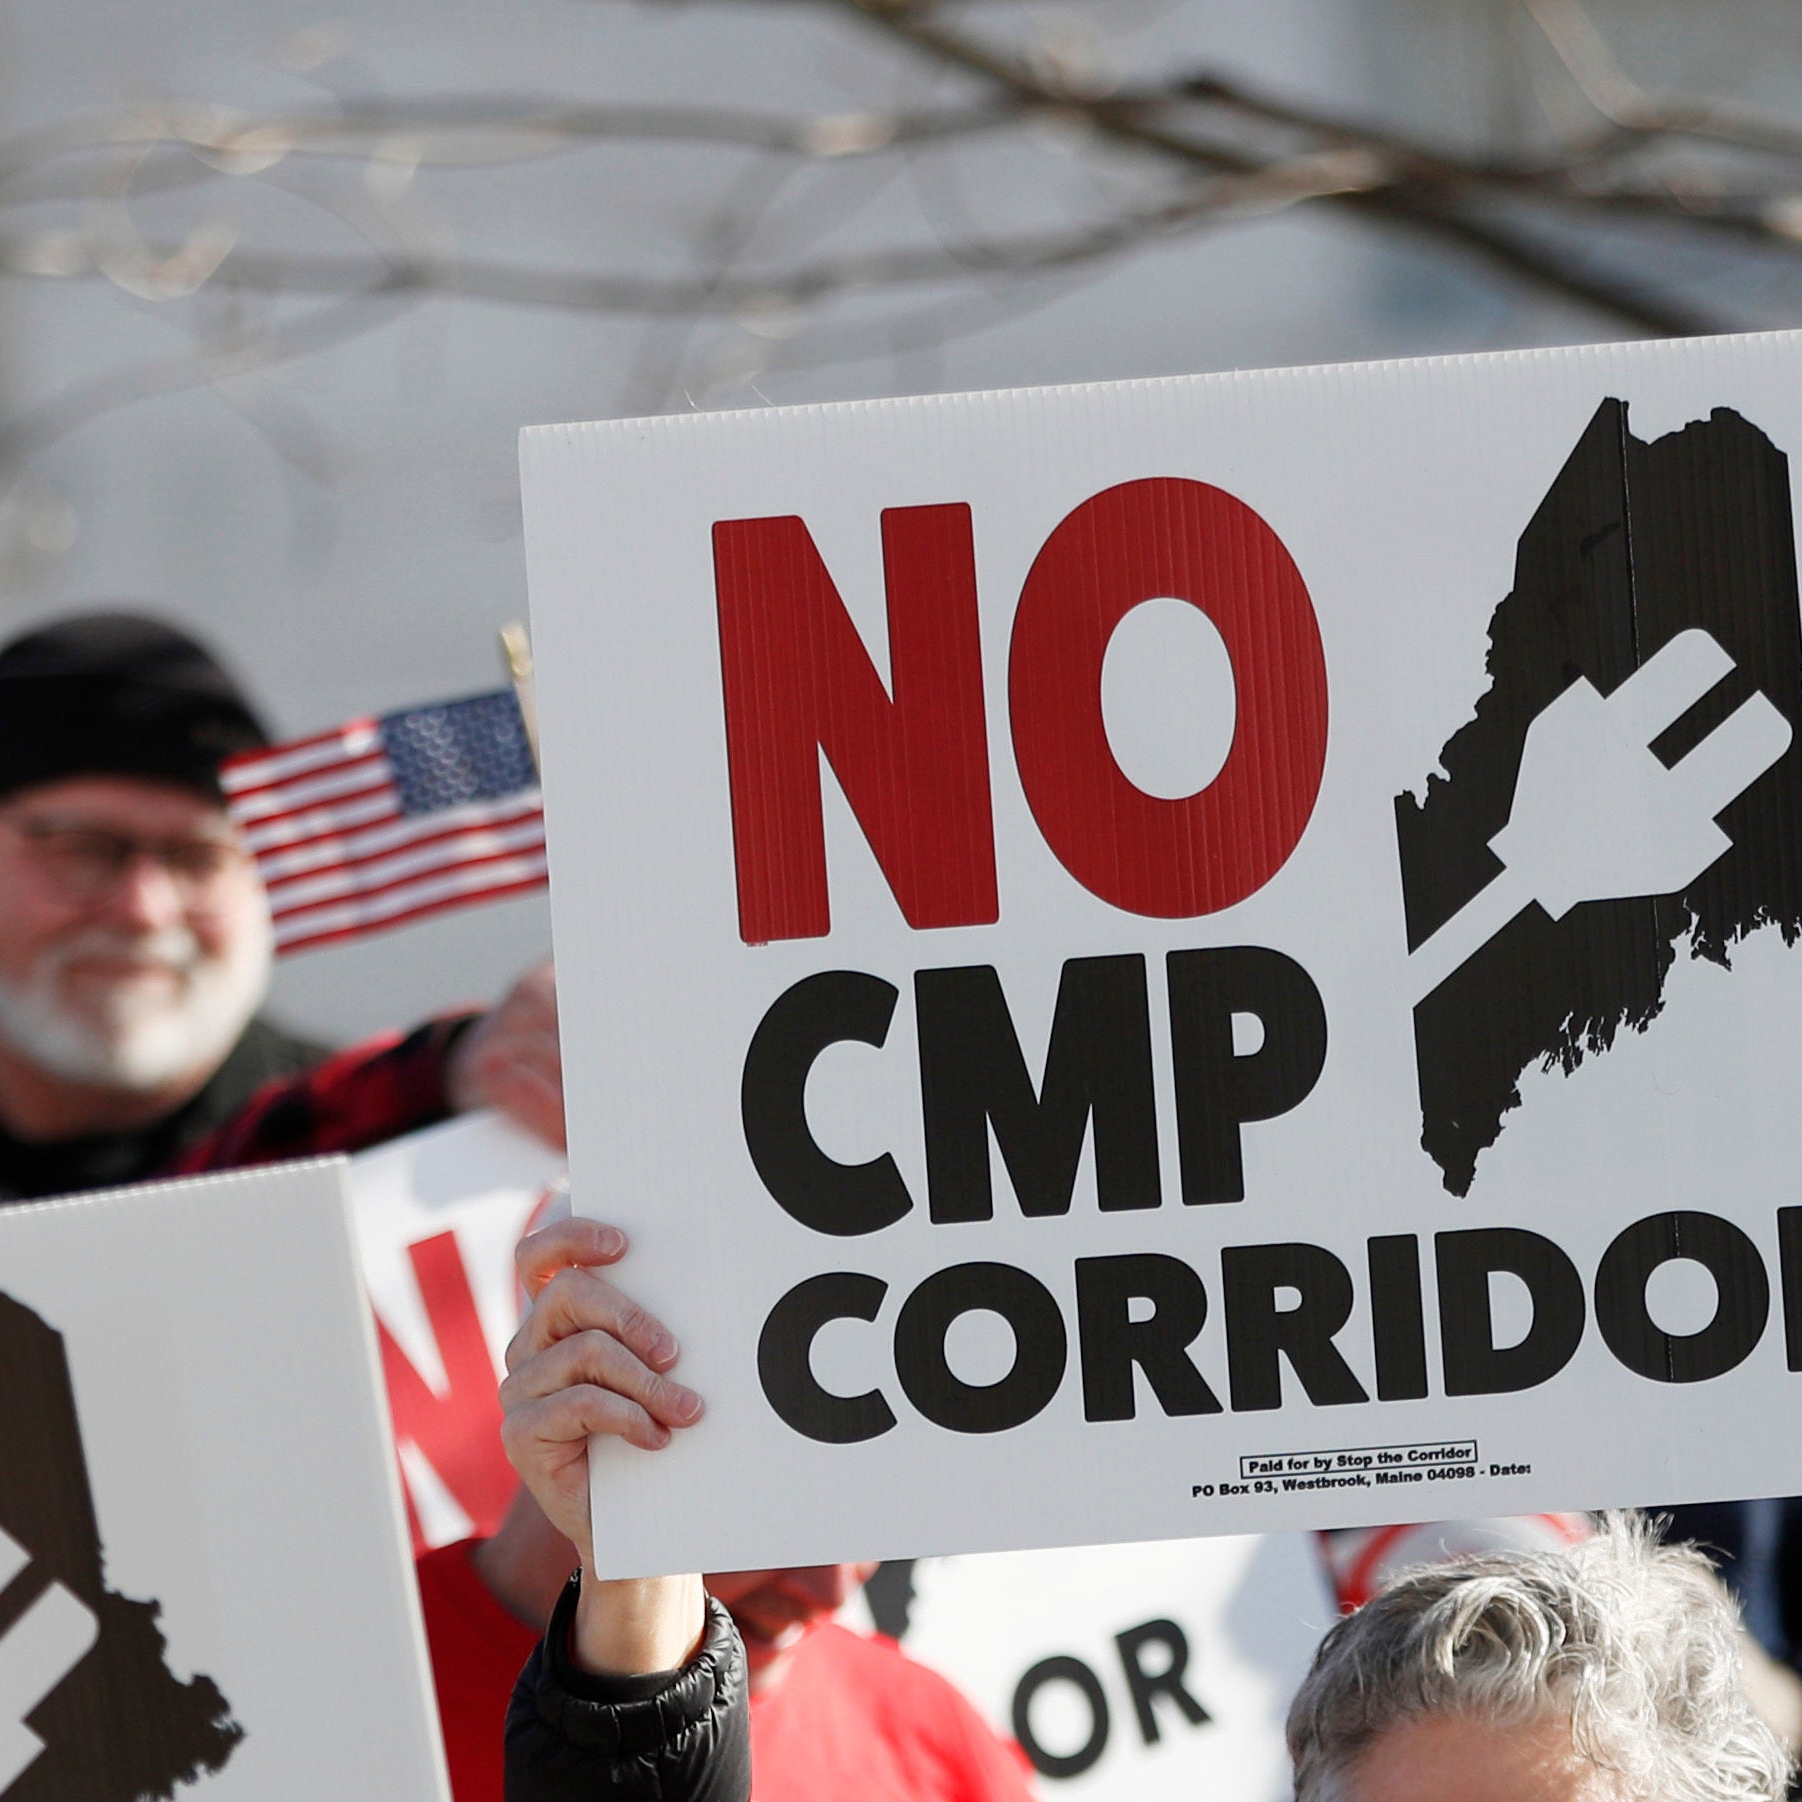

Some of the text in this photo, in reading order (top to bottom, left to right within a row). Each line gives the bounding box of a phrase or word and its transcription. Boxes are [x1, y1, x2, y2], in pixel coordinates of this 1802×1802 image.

[712, 477, 1329, 945] NO
[741, 946, 1328, 1237] CMP
[1192, 1485, 1214, 1498] PO
[1219, 1482, 1250, 1496] Box
[1254, 1481, 1278, 1495] 93,
[1283, 1474, 1371, 1492] Westbrook,
[1375, 1470, 1423, 1485] Maine
[1427, 1466, 1475, 1481] 04098
[1489, 1463, 1532, 1477] Date:
[1249, 1446, 1472, 1474] Paid for by Stop the Corridor
